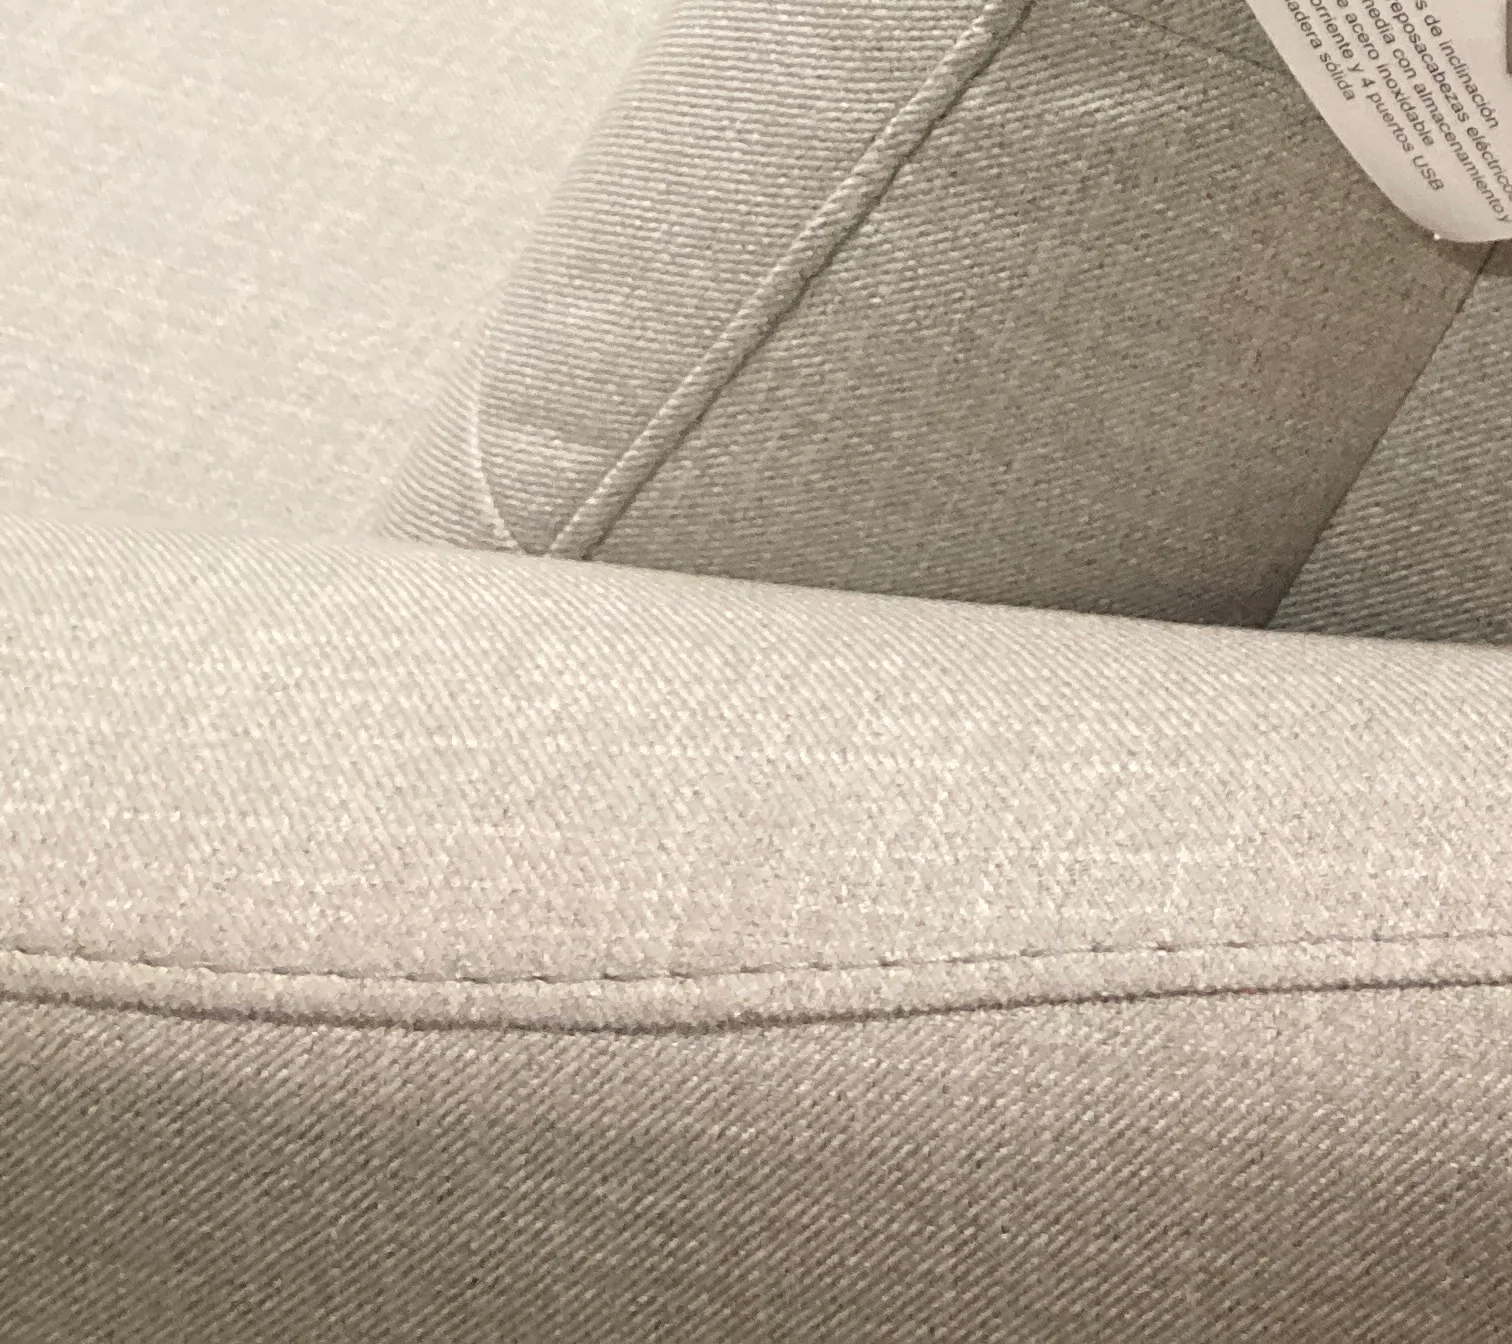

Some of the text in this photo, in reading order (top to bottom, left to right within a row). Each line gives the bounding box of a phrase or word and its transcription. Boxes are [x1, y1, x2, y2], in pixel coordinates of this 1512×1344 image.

[1318, 50, 1358, 102] sólida
[1343, 11, 1381, 62] acero
[1375, 61, 1436, 148] inoxidable
[1391, 47, 1418, 81] con
[1422, 12, 1445, 39] de
[1438, 38, 1501, 131] inclinación
[1365, 90, 1416, 154] puertos
[1410, 153, 1445, 193] USB
